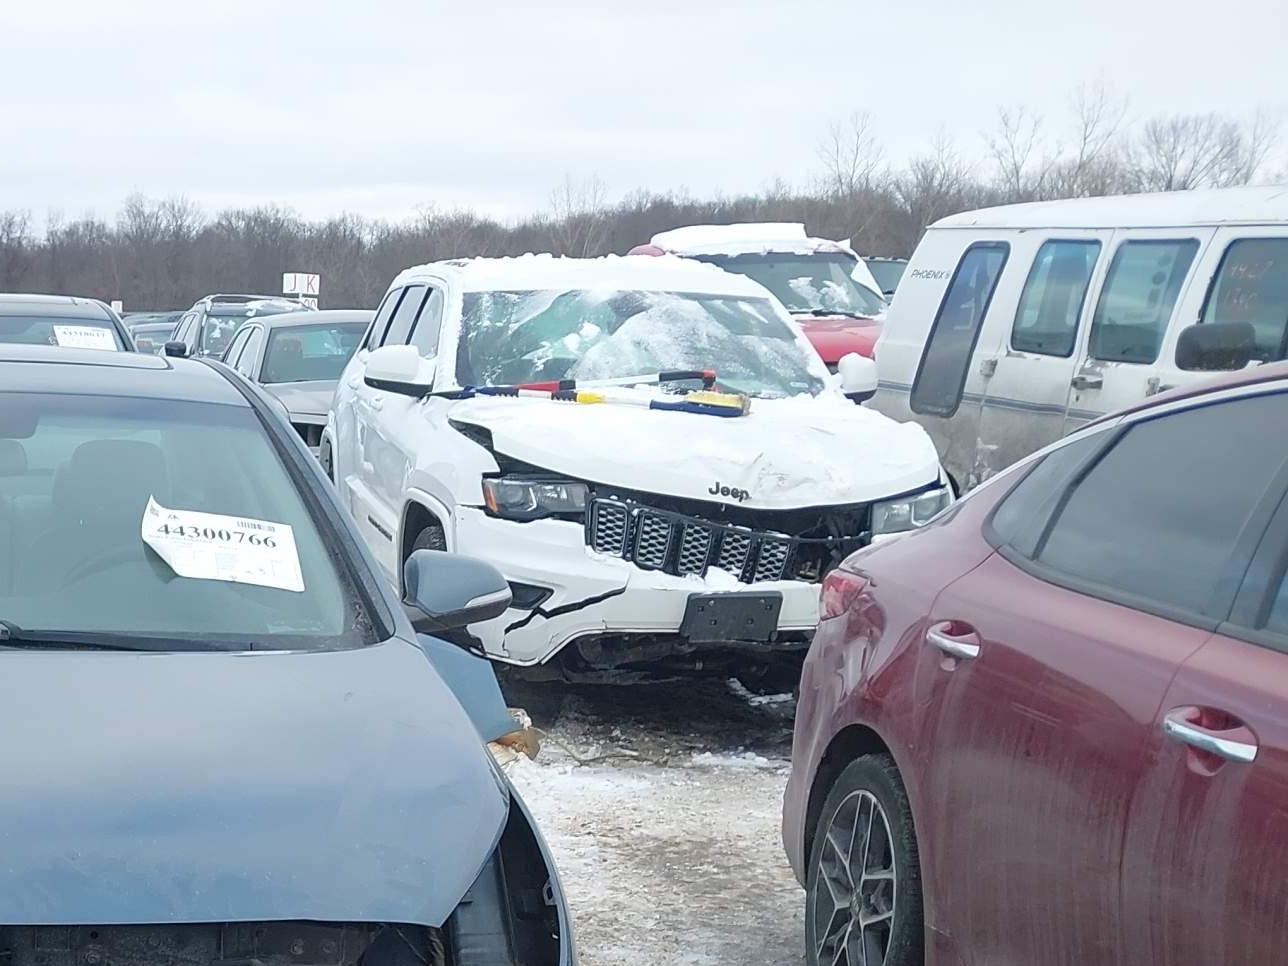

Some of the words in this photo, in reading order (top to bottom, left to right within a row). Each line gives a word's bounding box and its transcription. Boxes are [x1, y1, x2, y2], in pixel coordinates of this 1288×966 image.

[288, 274, 297, 291] J
[306, 275, 316, 293] K
[708, 481, 751, 502] Jeep
[156, 523, 276, 549] 44300766
